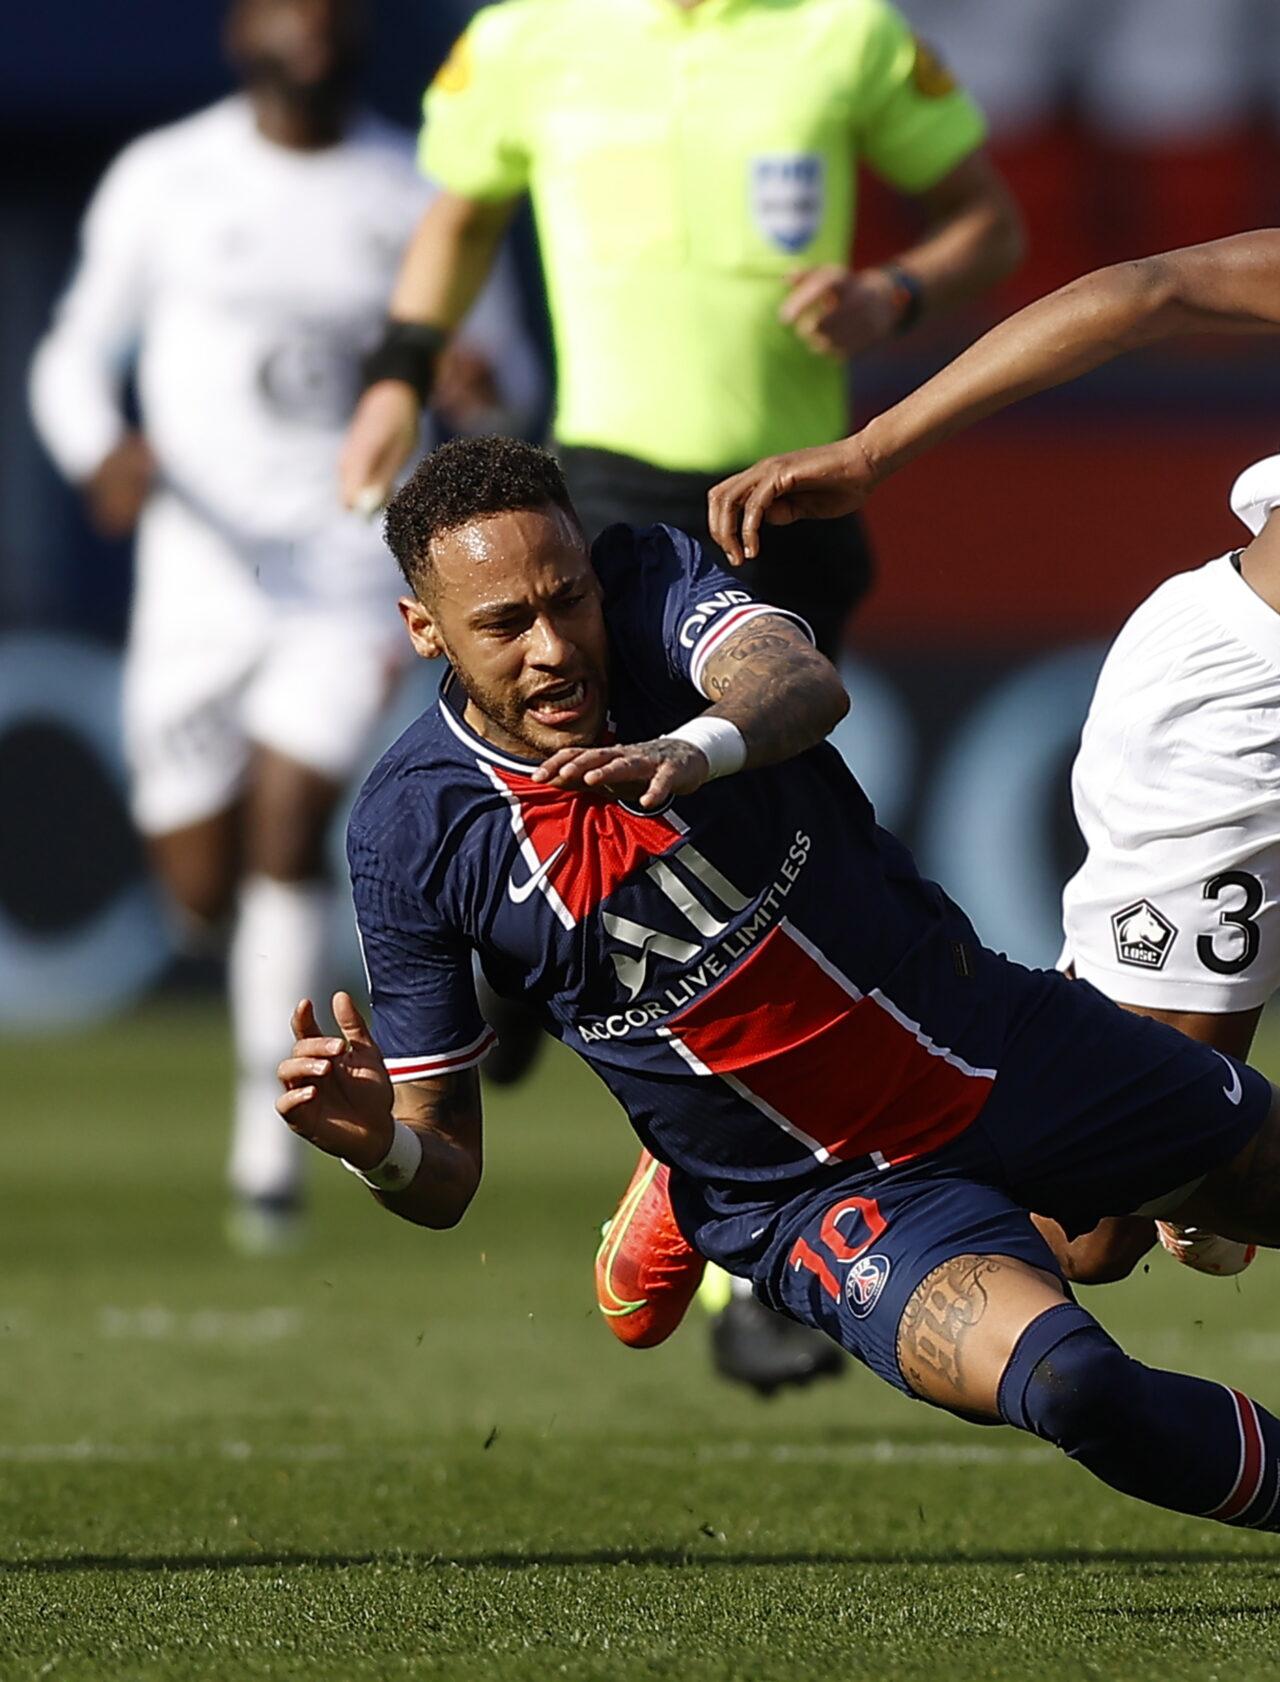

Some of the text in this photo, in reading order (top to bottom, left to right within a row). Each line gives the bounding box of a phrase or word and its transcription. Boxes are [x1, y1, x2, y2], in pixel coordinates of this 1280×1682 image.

[577, 829, 812, 1044] ACCOR LIVE LIMITLESS
[1123, 945, 1158, 963] LOSC
[1196, 870, 1265, 976] 3
[788, 1195, 888, 1305] 10
